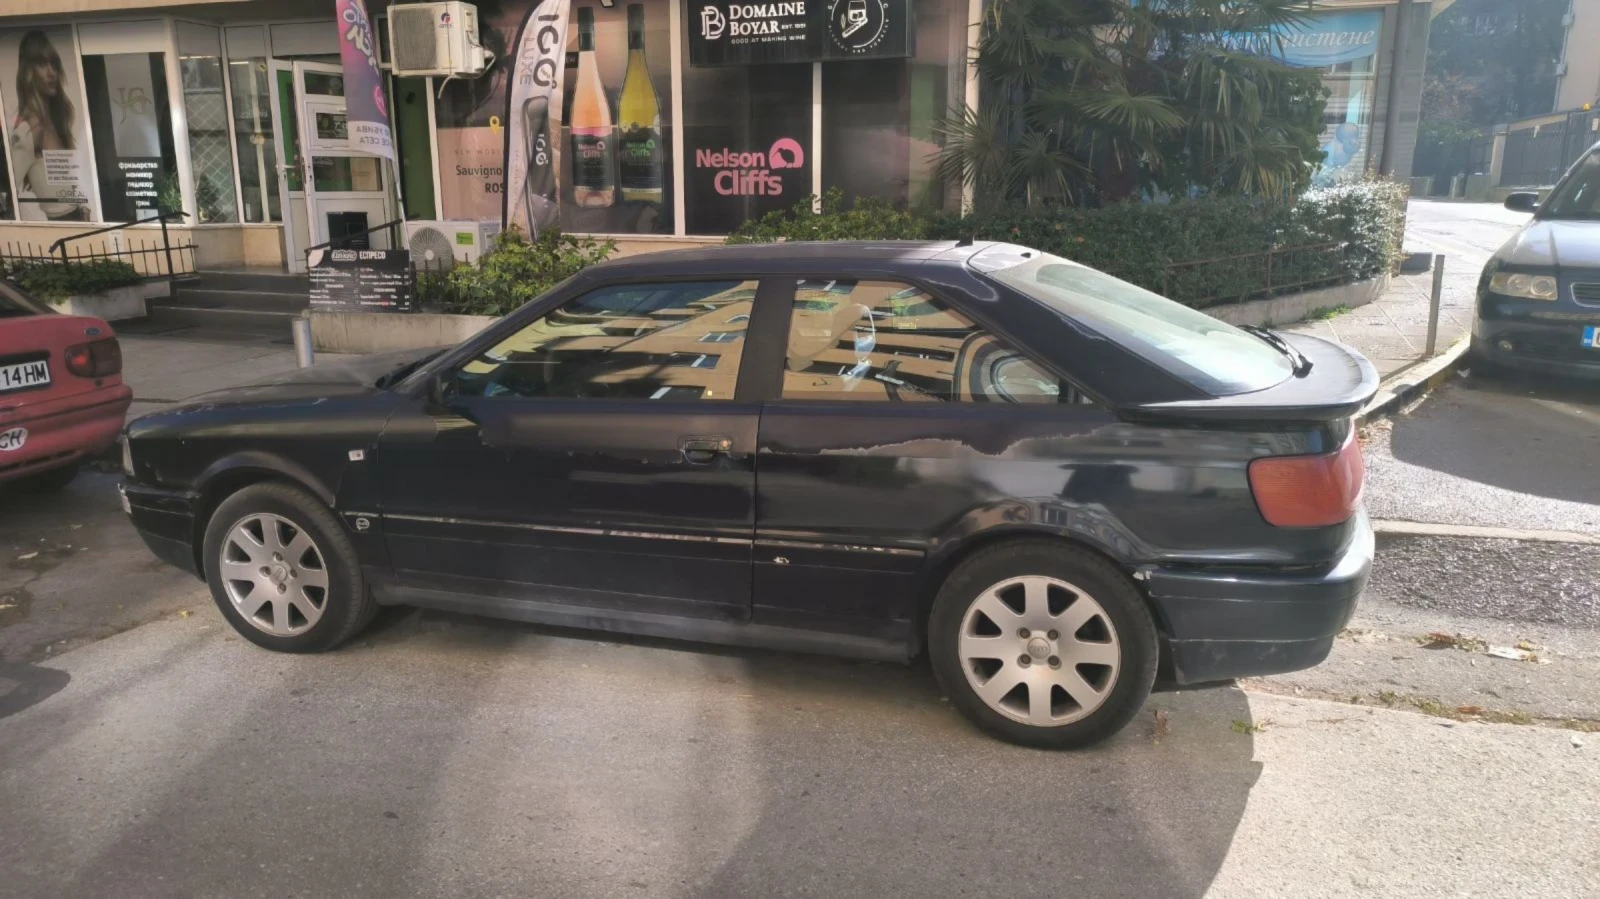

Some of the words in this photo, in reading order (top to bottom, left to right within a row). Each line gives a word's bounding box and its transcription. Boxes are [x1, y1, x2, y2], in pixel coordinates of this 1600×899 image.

[729, 2, 805, 19] DOMAINE
[730, 20, 780, 36] BOYAR
[520, 37, 535, 85] LUXE
[696, 148, 765, 168] Nelson
[455, 165, 503, 179] Sauvigno
[484, 183, 505, 193] ROS
[714, 170, 783, 196] Cliffs
[359, 250, 386, 260] ЕСПРЕСО
[0, 430, 23, 449] CH
